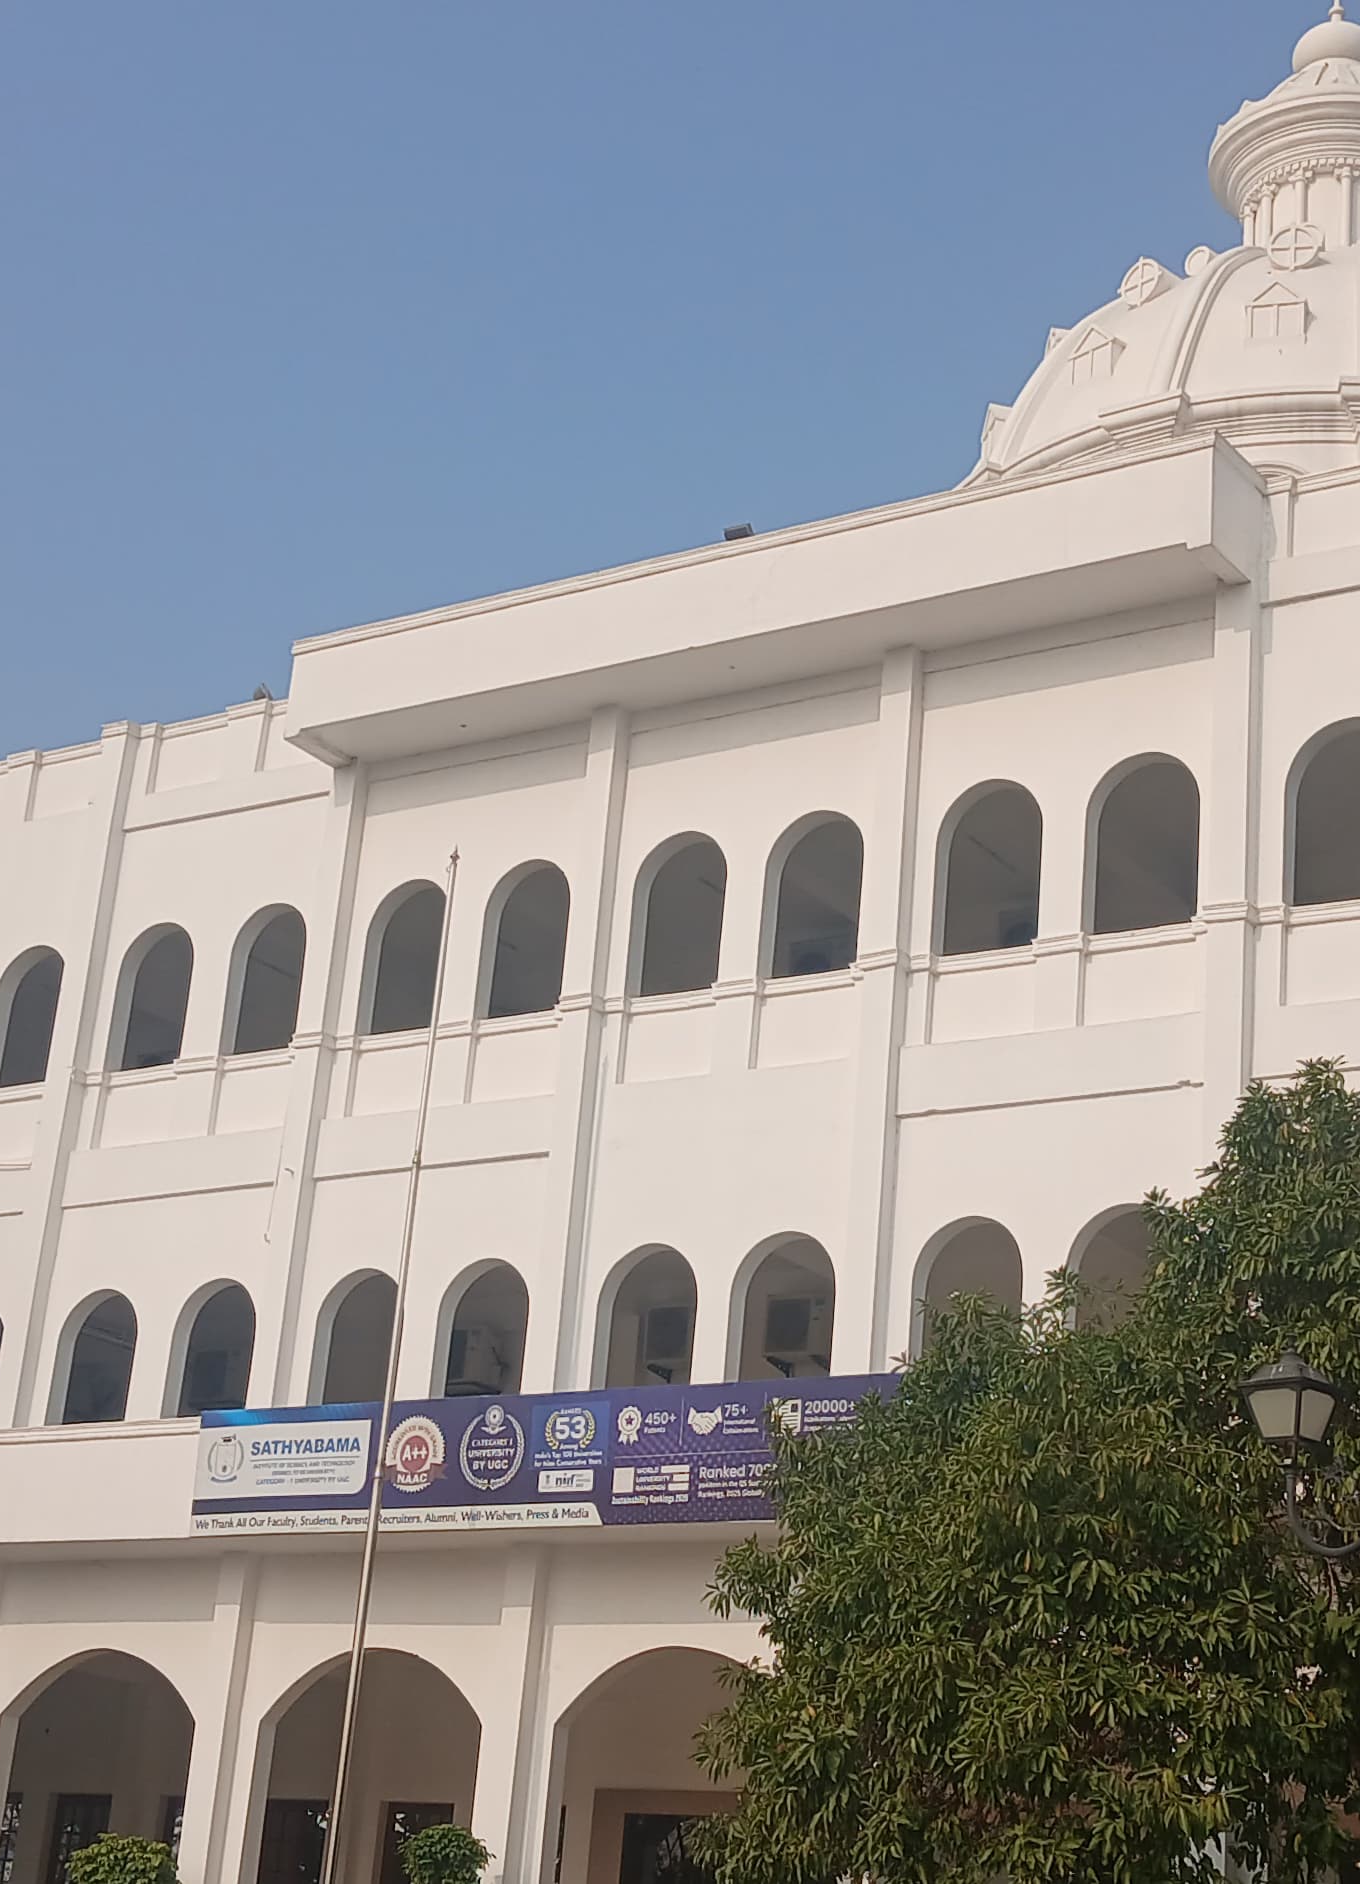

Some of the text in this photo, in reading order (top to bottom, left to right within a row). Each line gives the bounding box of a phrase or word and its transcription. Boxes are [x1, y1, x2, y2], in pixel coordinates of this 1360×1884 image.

[724, 1404, 749, 1417] 75+
[805, 1400, 857, 1414] 20000+
[644, 1412, 678, 1424] 450+
[555, 1416, 586, 1440] 53
[251, 1438, 361, 1456] SATHYABAMA
[402, 1444, 428, 1461] A++
[468, 1448, 515, 1458] UNIVERSITY
[473, 1459, 509, 1471] BY UGC
[699, 1464, 746, 1479] Ranked
[397, 1473, 428, 1484] NAAC
[195, 1519, 210, 1529] We
[211, 1517, 234, 1528] Thank
[236, 1517, 248, 1527] All
[249, 1517, 265, 1527] Our
[268, 1516, 299, 1529] Faculty,
[300, 1515, 339, 1526] Students,
[341, 1514, 370, 1525] Parent
[526, 1509, 549, 1520] Press
[551, 1508, 559, 1518] &
[561, 1508, 590, 1518] Media
